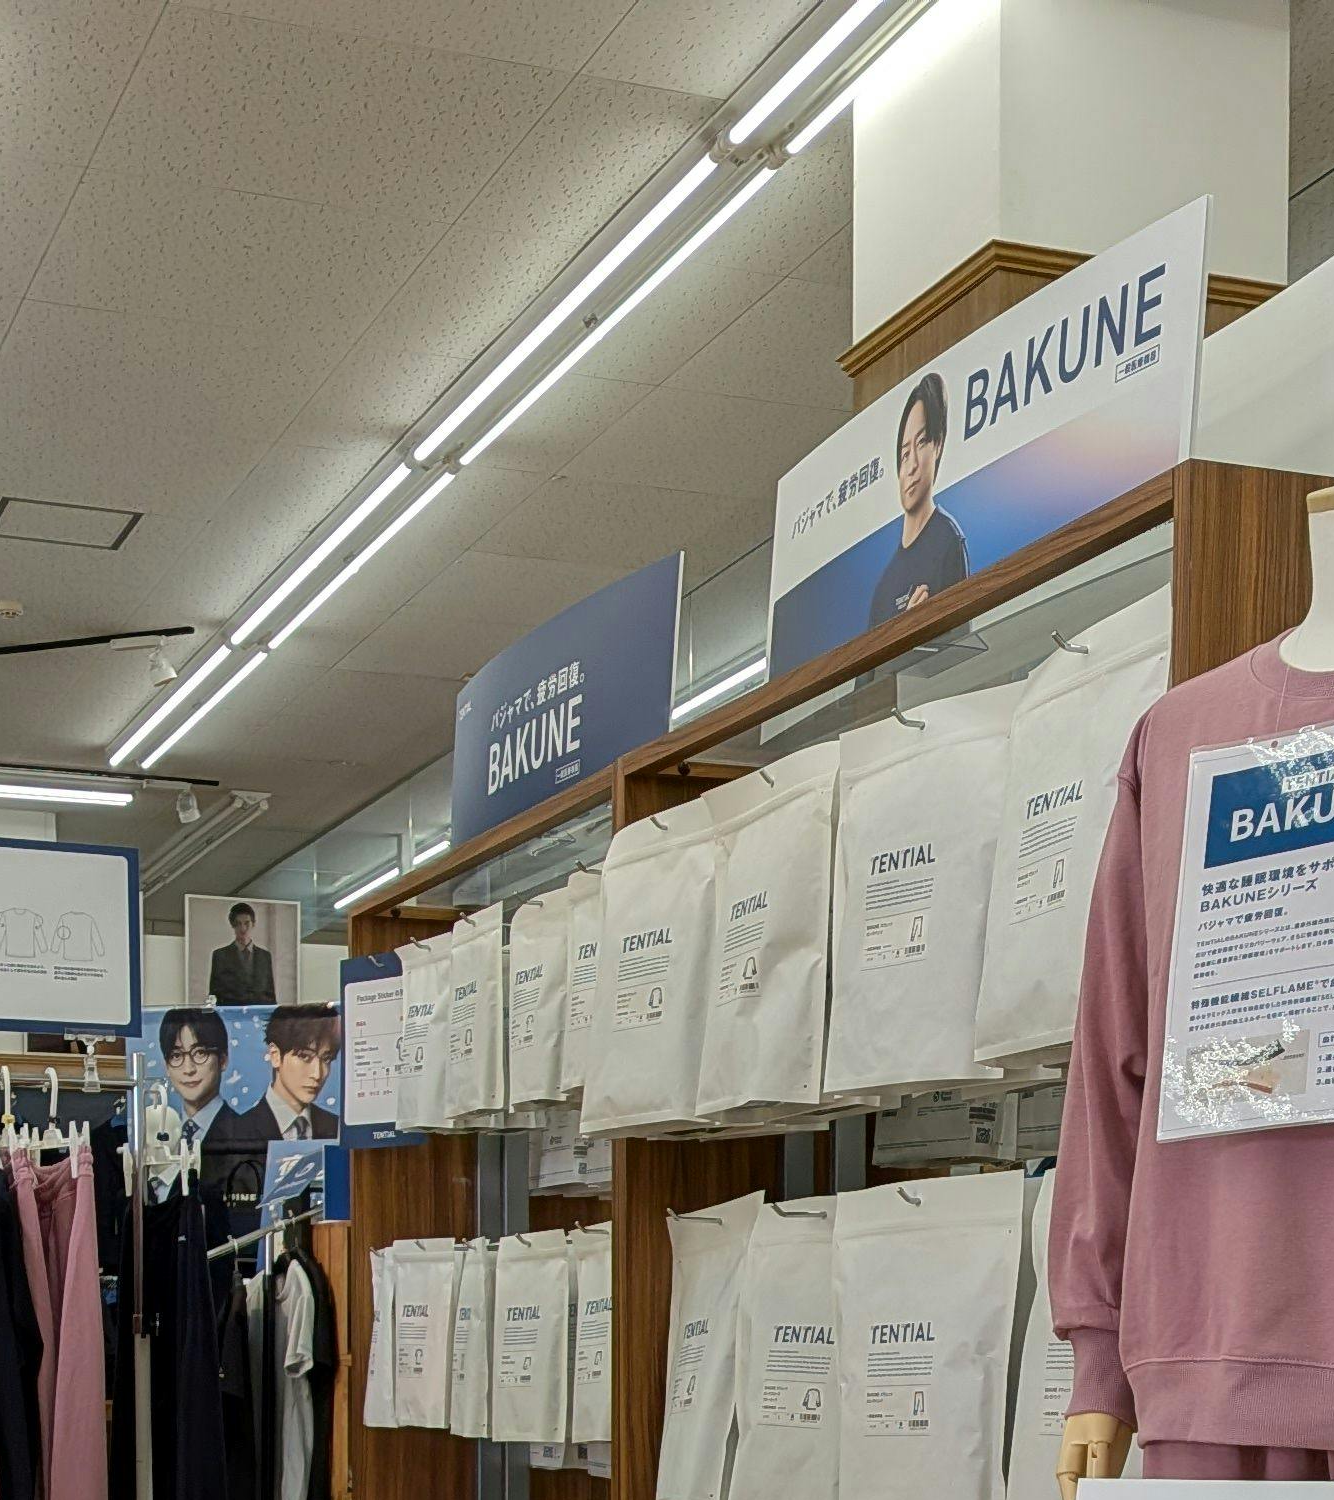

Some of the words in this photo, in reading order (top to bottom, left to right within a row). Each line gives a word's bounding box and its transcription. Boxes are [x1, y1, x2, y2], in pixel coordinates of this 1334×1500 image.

[963, 262, 1167, 440] BAKUNE
[791, 456, 885, 540] パジャマで、疲労回復。
[491, 661, 584, 731] パジャマで、疲労回復。
[488, 694, 583, 795] BAKUNE
[1026, 779, 1083, 820] TENTIAL
[870, 843, 936, 876] TENTIAL
[730, 891, 768, 923] TENTIAL
[1200, 878, 1317, 912] BAKUNEシリーズ
[622, 928, 672, 954] TENTIAL
[507, 1305, 540, 1321] TENTIAL
[773, 1324, 835, 1345] TENTIAL
[870, 1321, 935, 1345] TENTIAL
